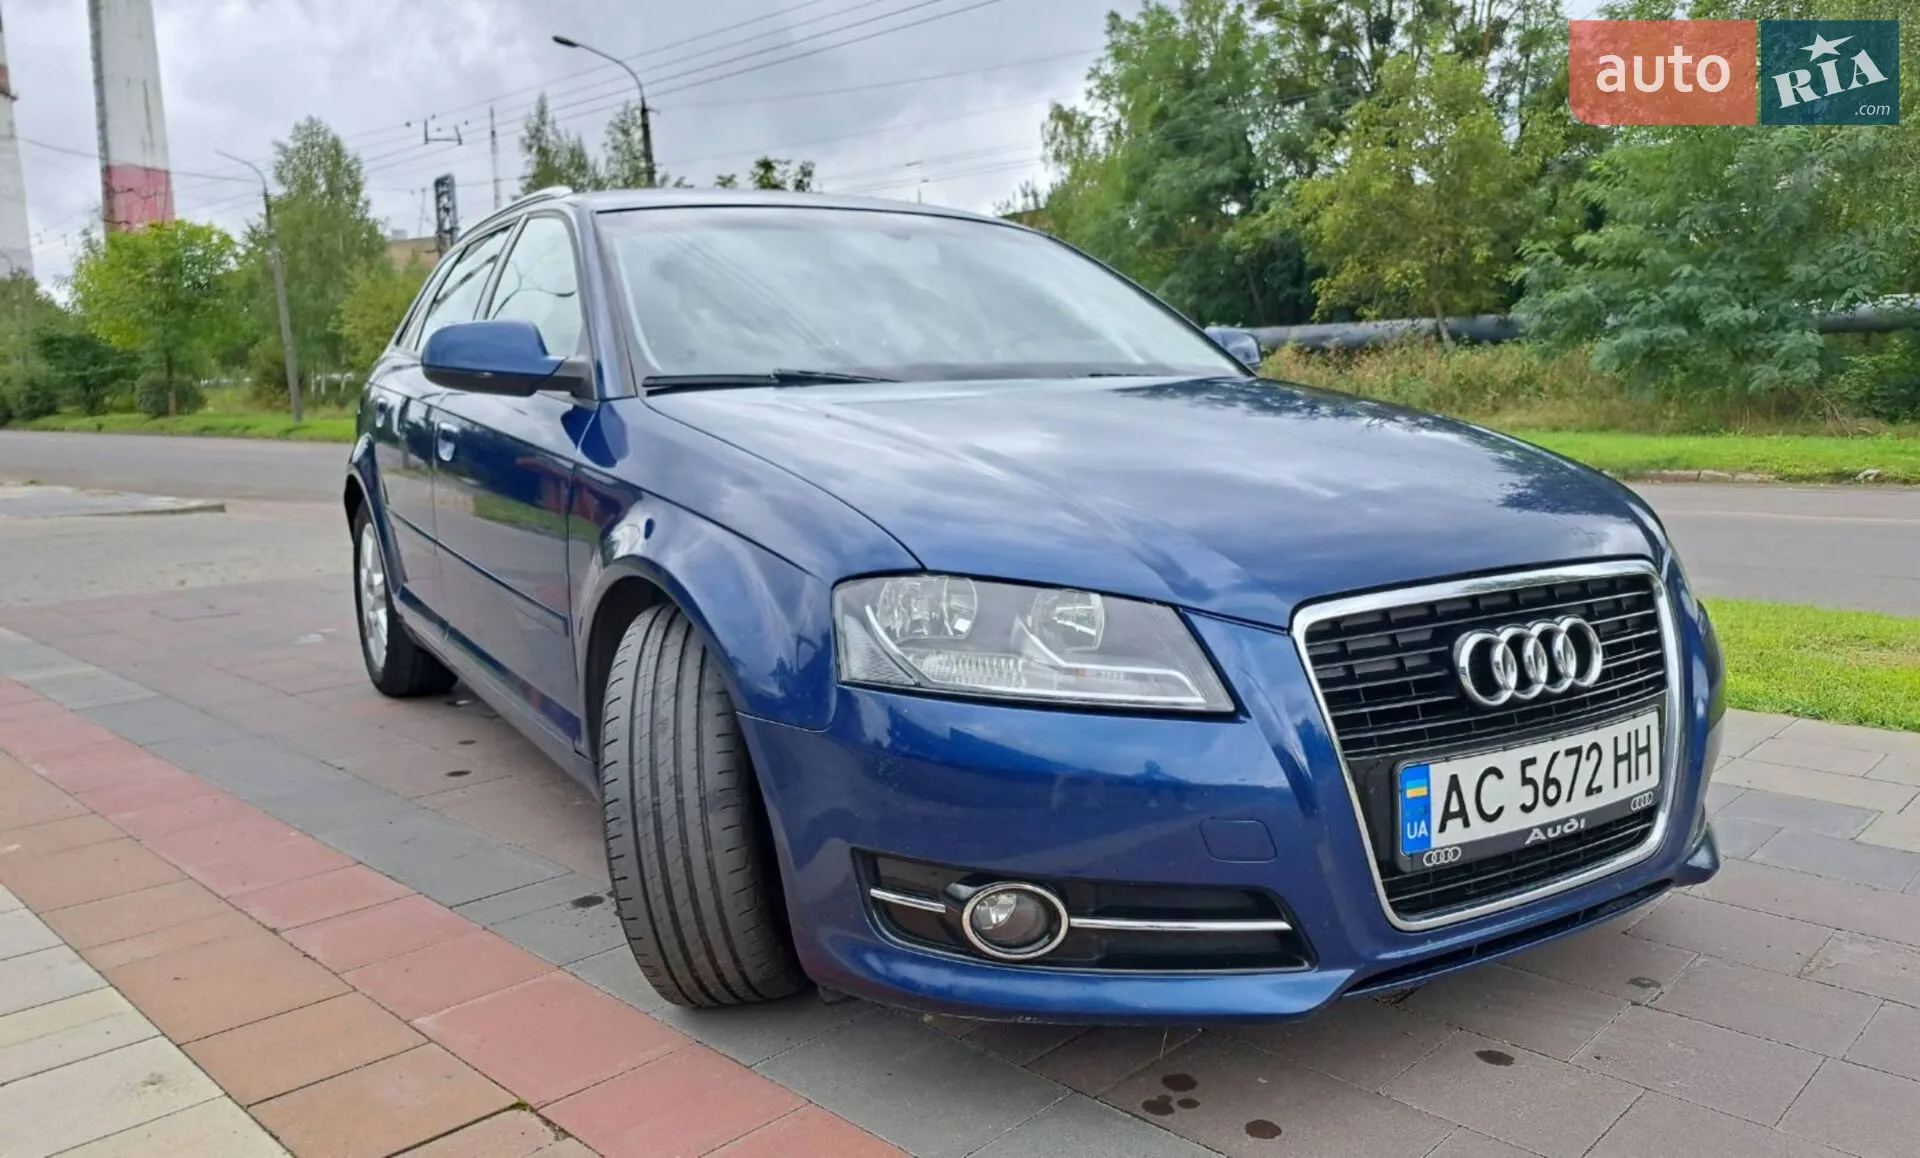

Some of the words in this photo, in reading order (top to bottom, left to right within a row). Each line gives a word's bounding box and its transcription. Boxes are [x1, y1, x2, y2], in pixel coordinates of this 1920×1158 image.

[1438, 767, 1504, 834] AC
[1519, 741, 1603, 814] 5672
[1613, 725, 1652, 789] HH
[1406, 820, 1429, 840] UA
[1524, 817, 1586, 845] Audi
